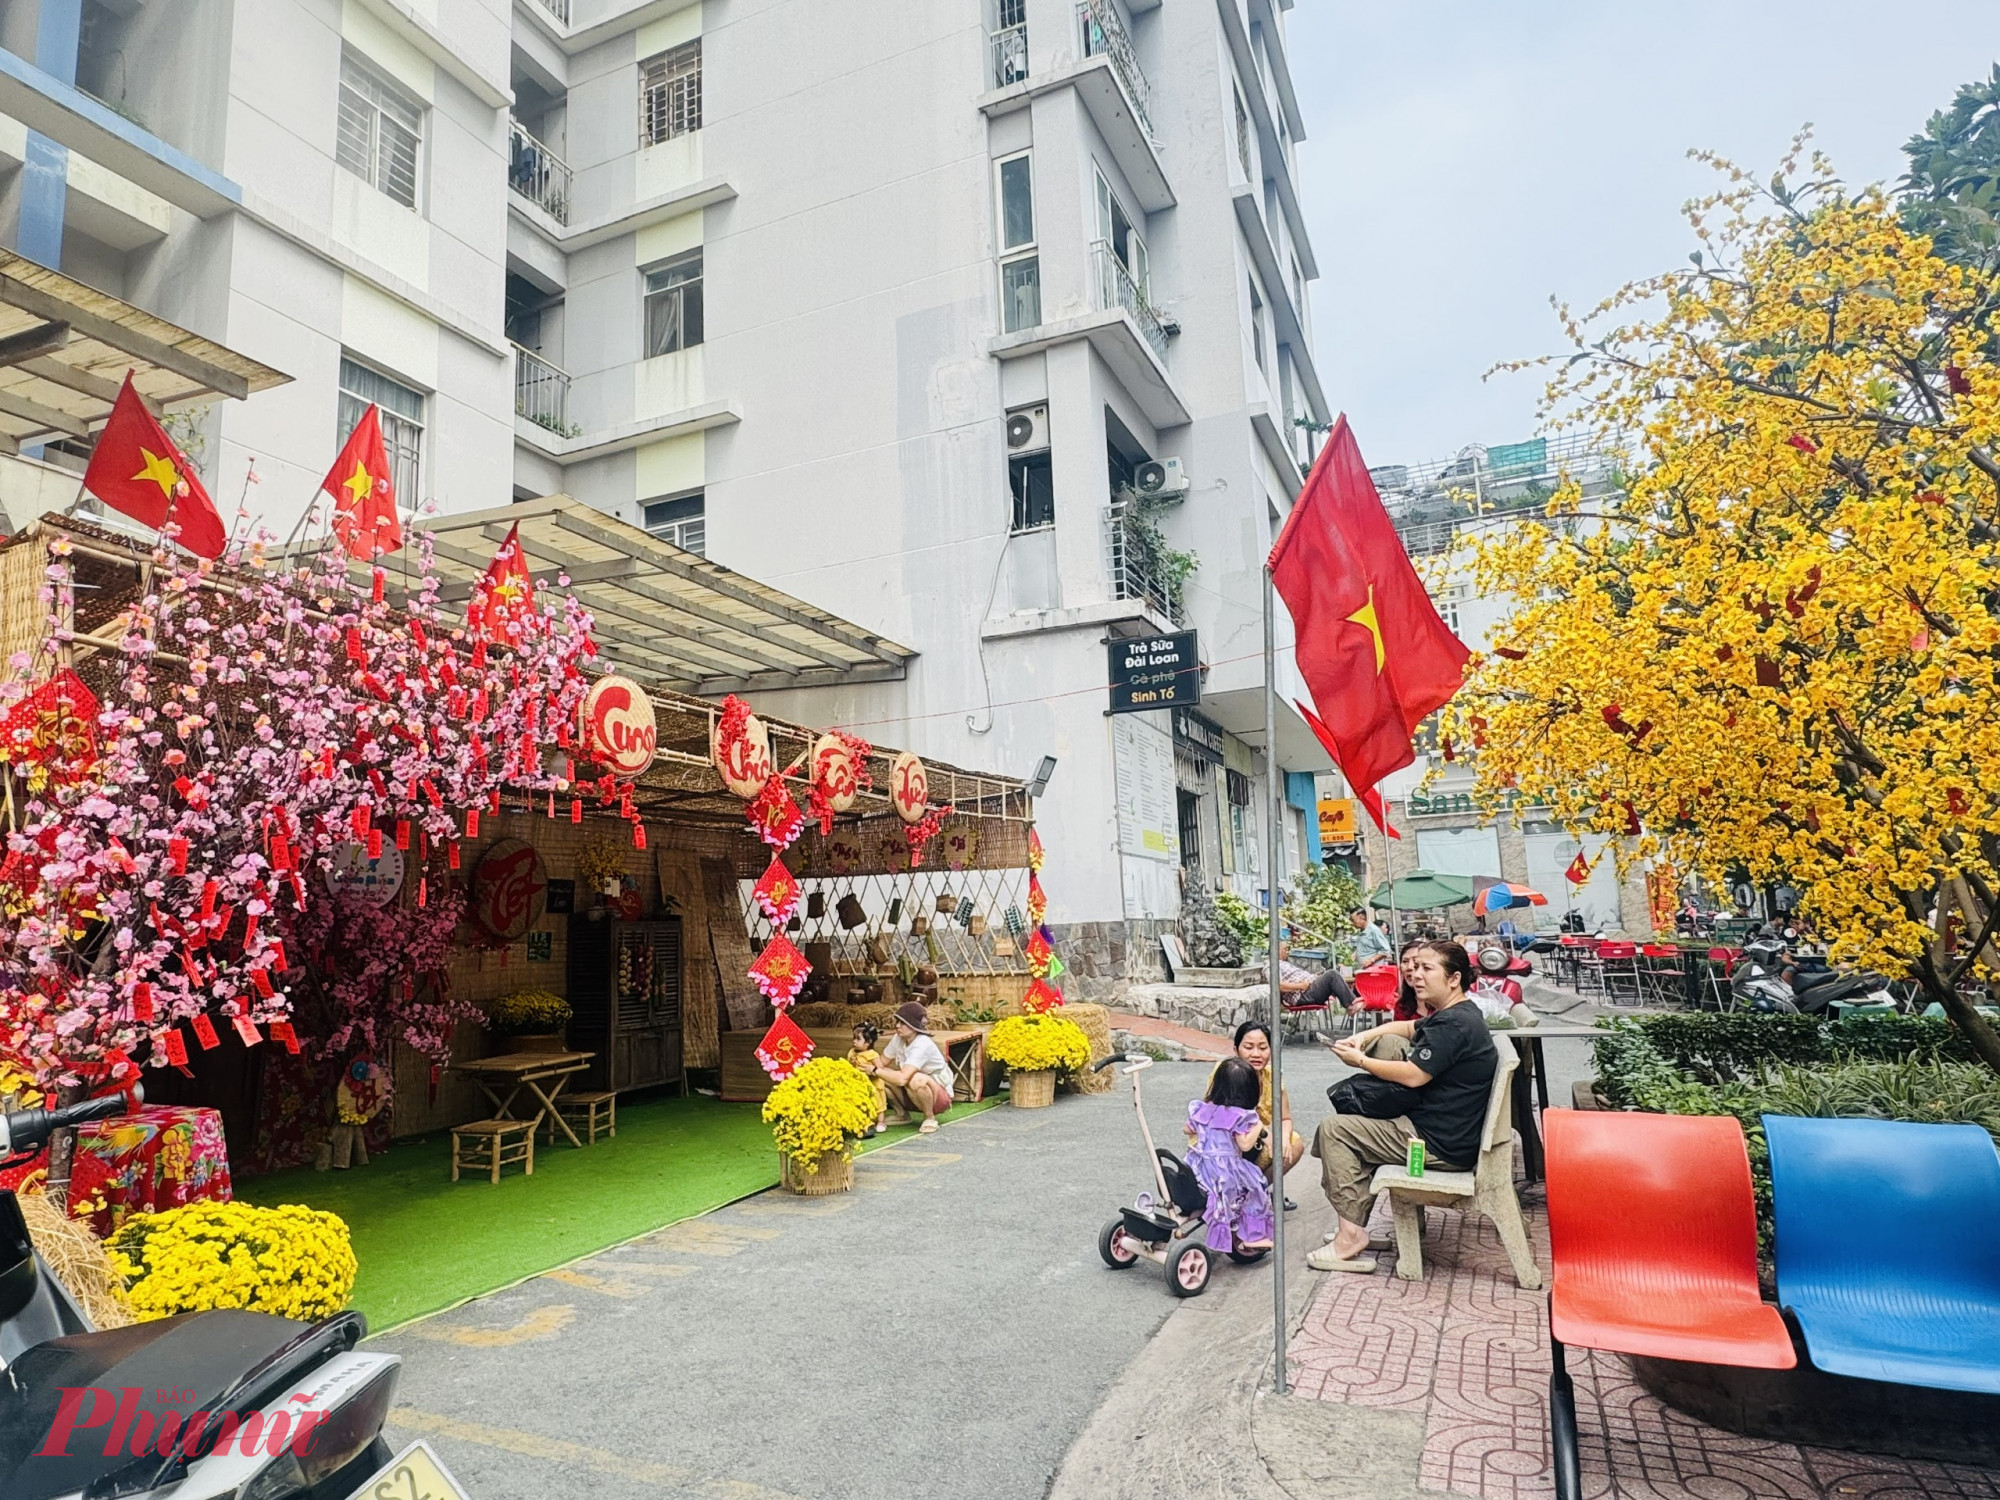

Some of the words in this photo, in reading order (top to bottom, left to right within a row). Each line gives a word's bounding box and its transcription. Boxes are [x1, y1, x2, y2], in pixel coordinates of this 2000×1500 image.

[1129, 642, 1148, 655] Trà
[1150, 640, 1174, 652] Sữa
[1125, 655, 1146, 669] Đài
[1149, 653, 1179, 665] Loan
[1130, 673, 1148, 685] Cà
[1152, 669, 1175, 685] phê
[1131, 690, 1157, 703] Sinh
[1159, 685, 1175, 700] Tố
